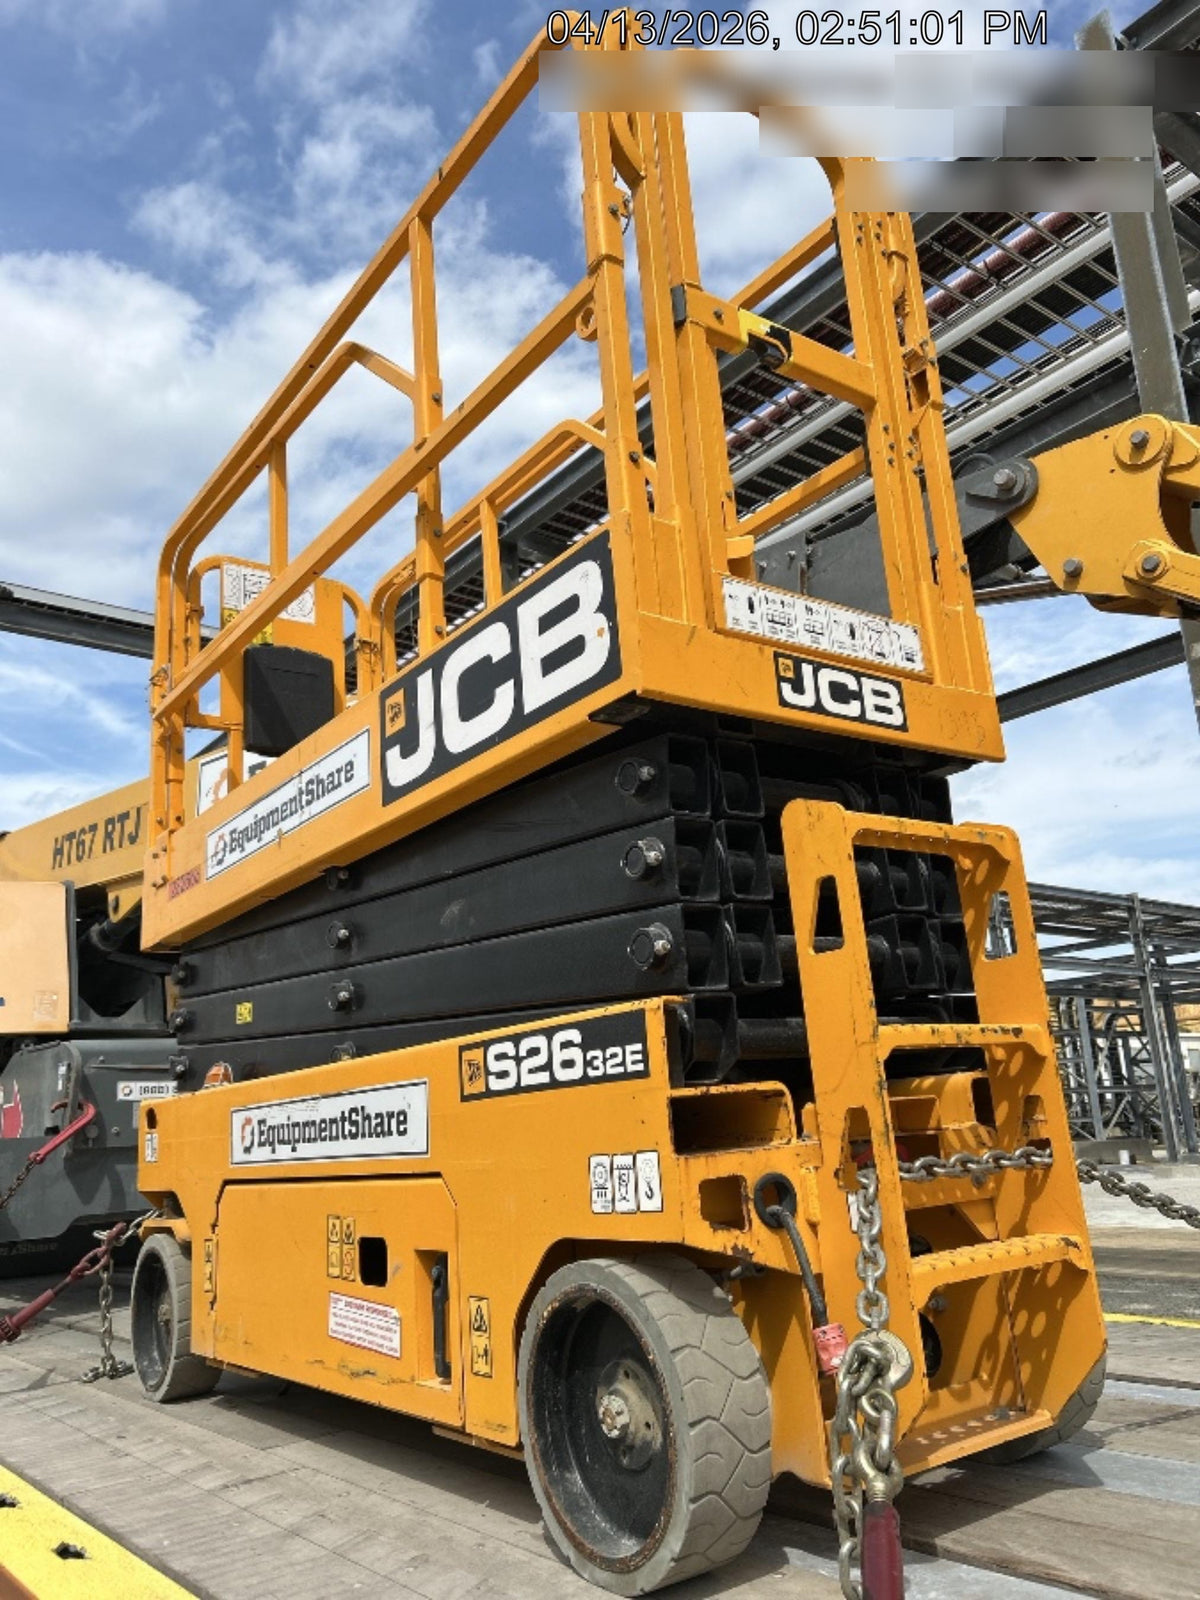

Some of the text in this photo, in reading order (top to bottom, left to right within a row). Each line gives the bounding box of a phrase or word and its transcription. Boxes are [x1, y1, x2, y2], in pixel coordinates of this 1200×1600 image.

[385, 559, 611, 788] JCB
[780, 662, 904, 727] JCB
[51, 806, 142, 870] HT67 RTJ
[228, 757, 356, 854] EquipmentShare
[257, 1105, 409, 1155] EquipmentShare
